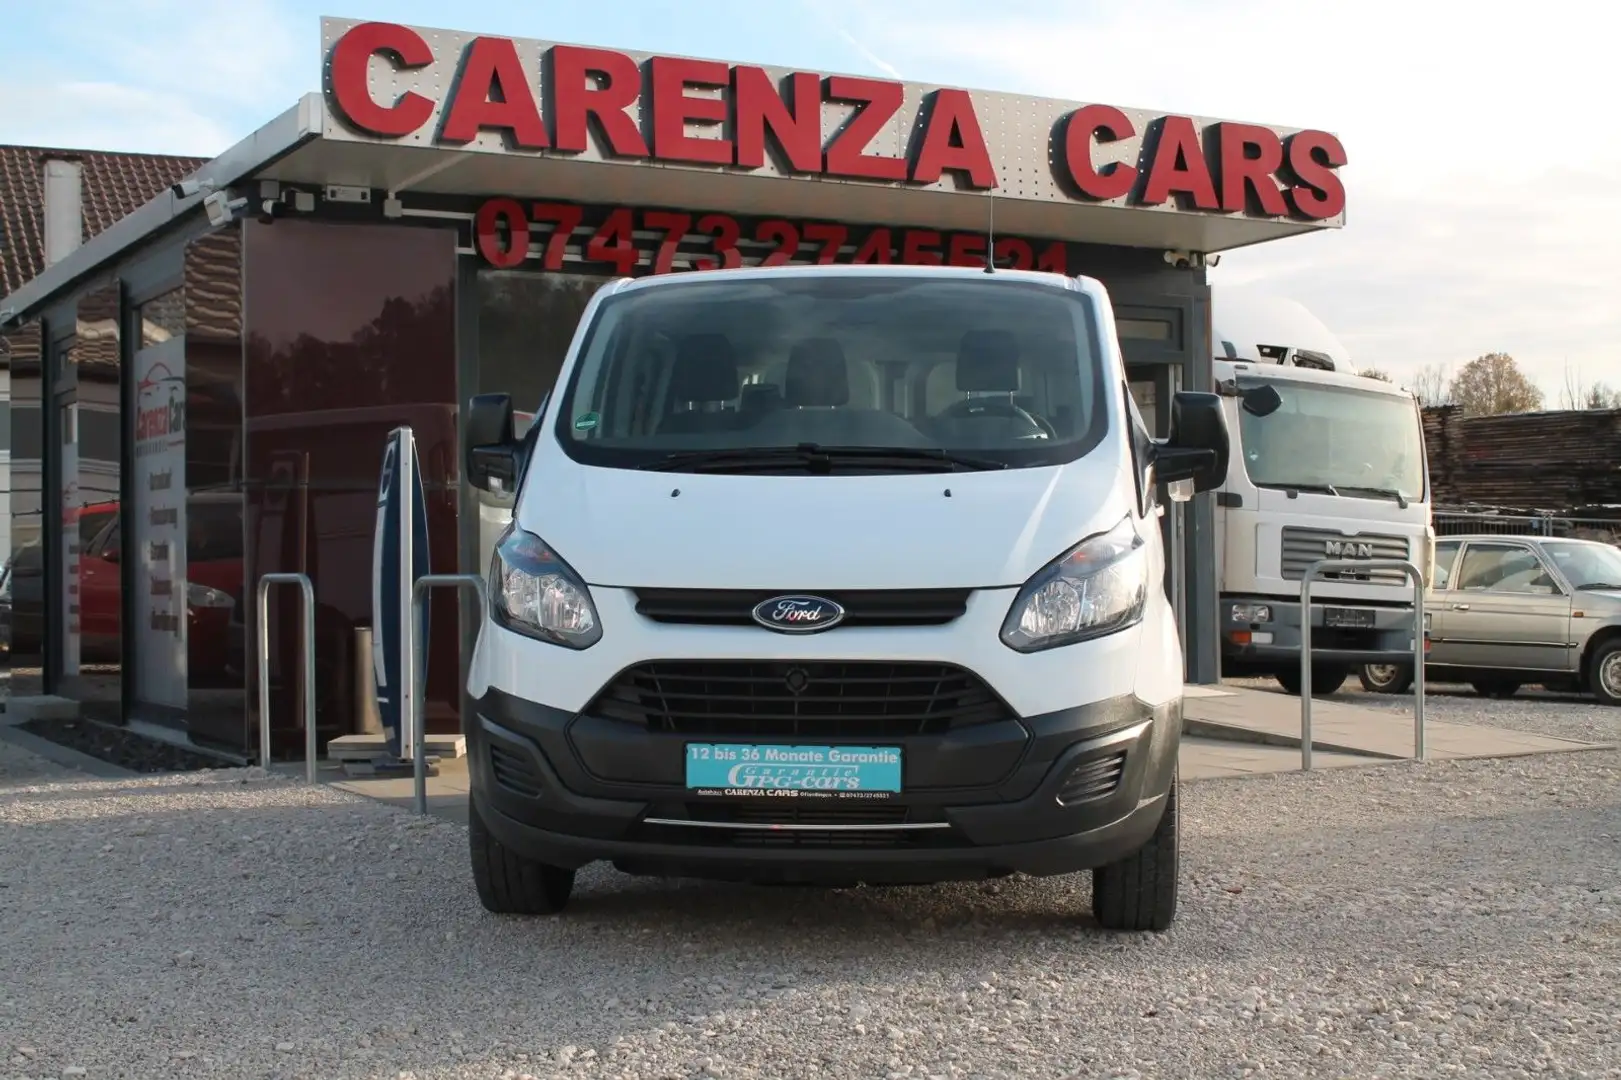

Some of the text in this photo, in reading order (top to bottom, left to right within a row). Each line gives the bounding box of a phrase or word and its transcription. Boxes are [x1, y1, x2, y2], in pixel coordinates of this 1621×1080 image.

[324, 22, 1348, 220] CARENZA CARS
[1326, 541, 1373, 556] MAN
[772, 600, 821, 621] Ford
[692, 747, 898, 763] 12 bis 36 Monate Garantie
[725, 788, 764, 796] CARENZA
[766, 789, 798, 797] CARS
